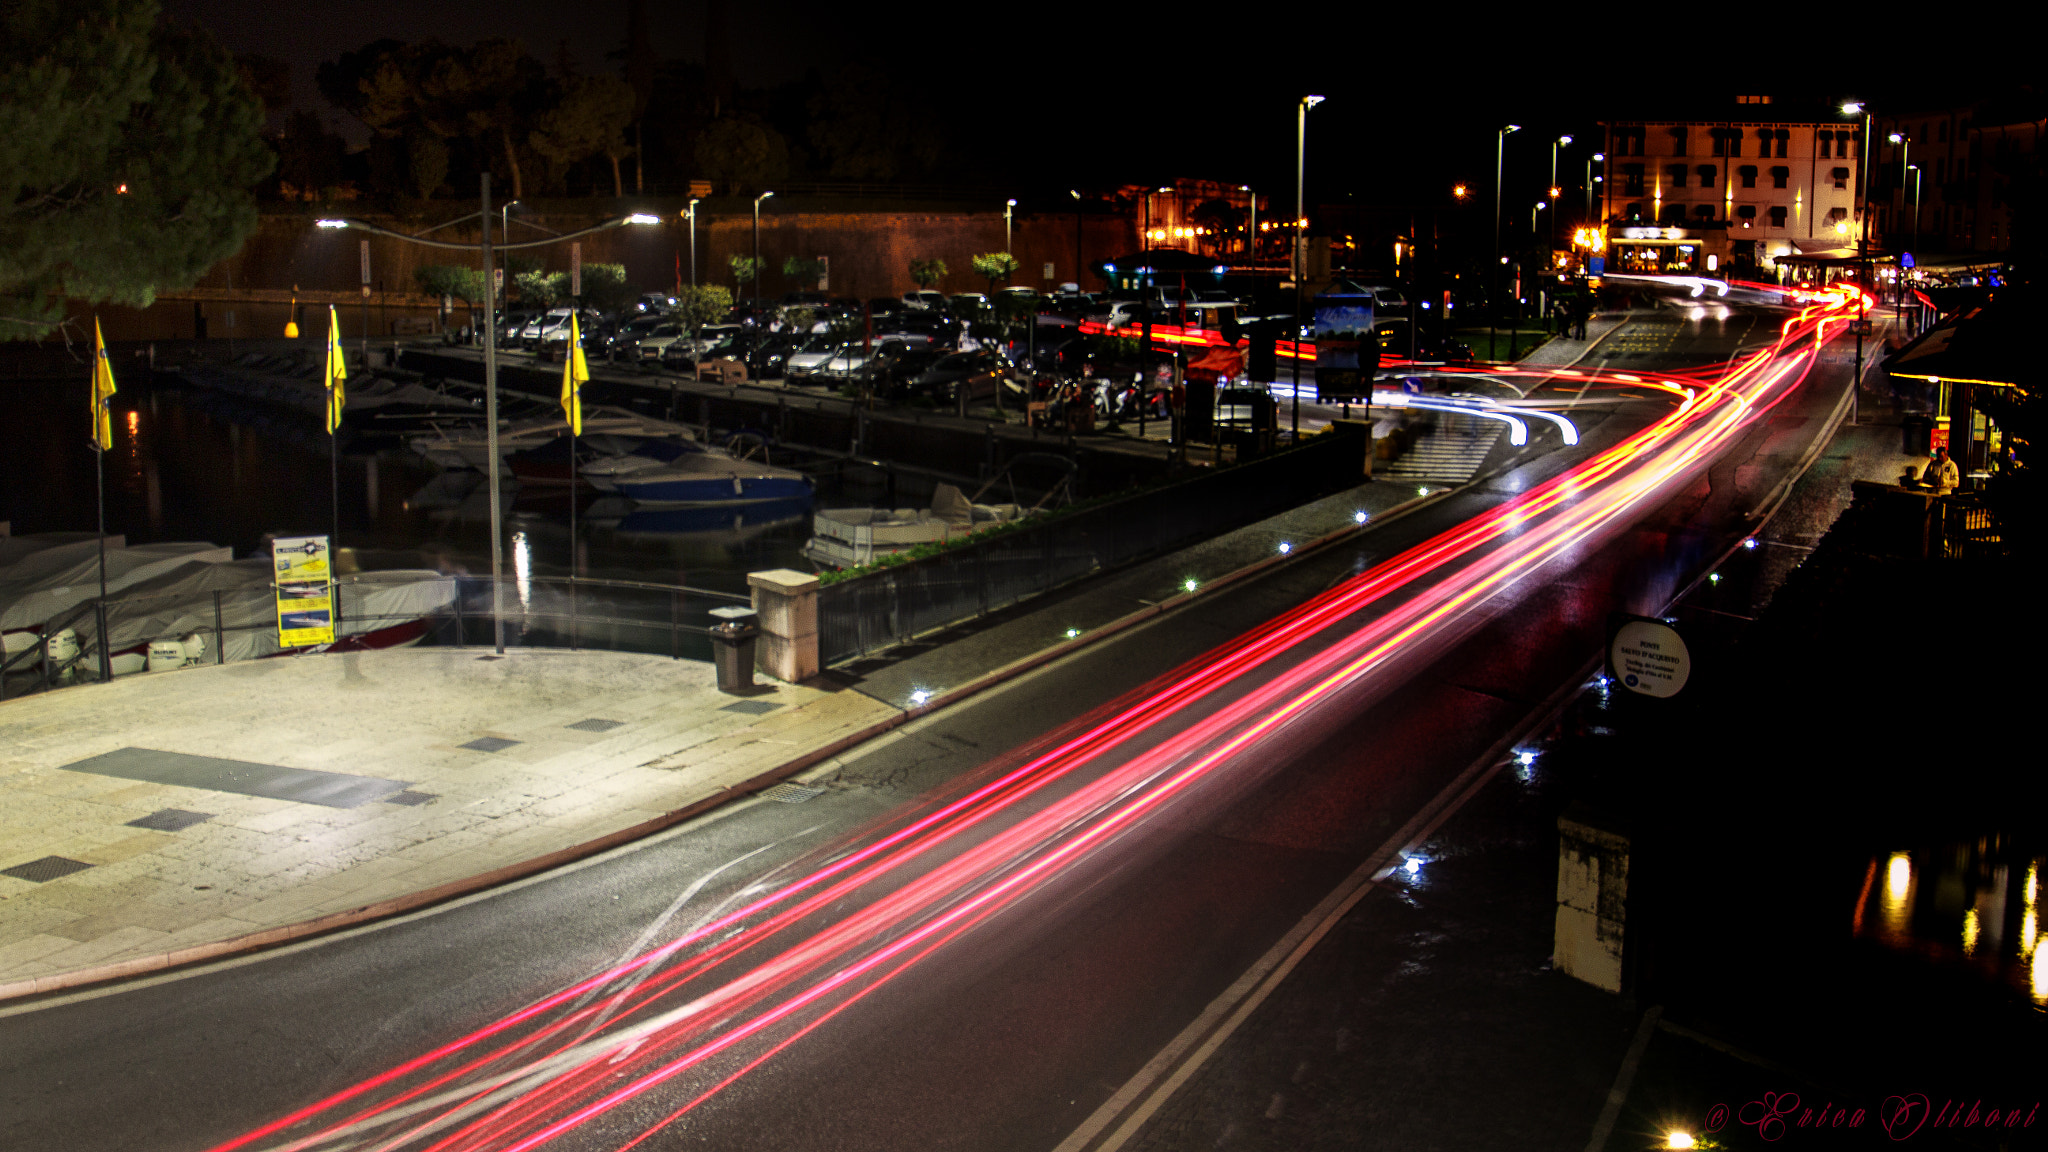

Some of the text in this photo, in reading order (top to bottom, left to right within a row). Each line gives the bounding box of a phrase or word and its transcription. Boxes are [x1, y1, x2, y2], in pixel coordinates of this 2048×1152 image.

[1640, 641, 1660, 650] PONTE
[1621, 647, 1680, 664] SALVO D'ACQUISTO
